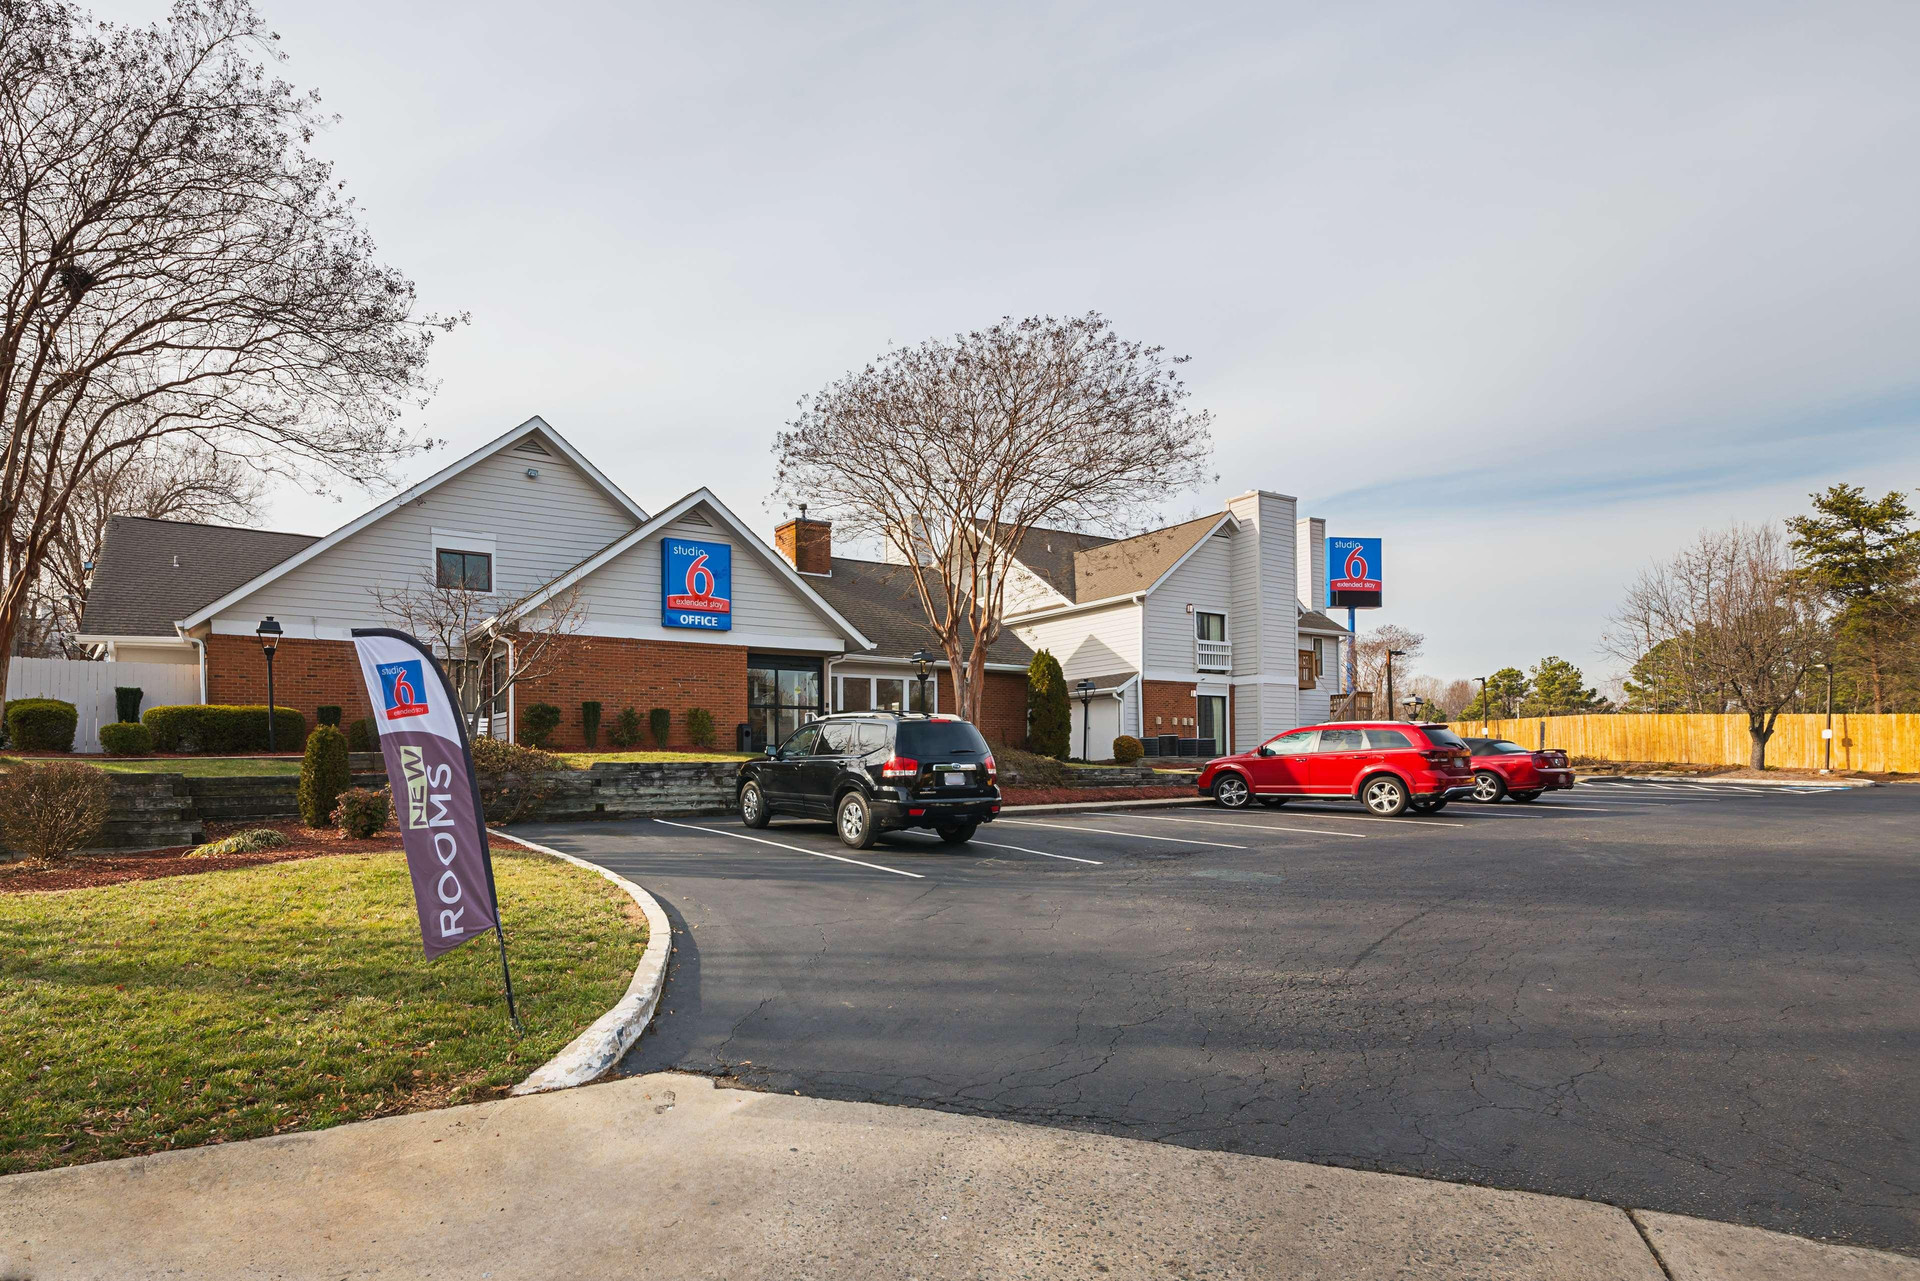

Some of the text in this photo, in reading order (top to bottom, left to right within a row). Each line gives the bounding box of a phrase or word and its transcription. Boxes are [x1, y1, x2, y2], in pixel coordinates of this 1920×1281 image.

[673, 545, 706, 557] studio
[1335, 540, 1361, 549] studio
[685, 554, 715, 597] 6
[1344, 545, 1369, 580] 6
[676, 598, 723, 609] extended stay
[679, 614, 718, 626] OFFICE
[394, 670, 414, 706] 6
[403, 748, 428, 827] NEW
[426, 763, 464, 938] ROOMS
